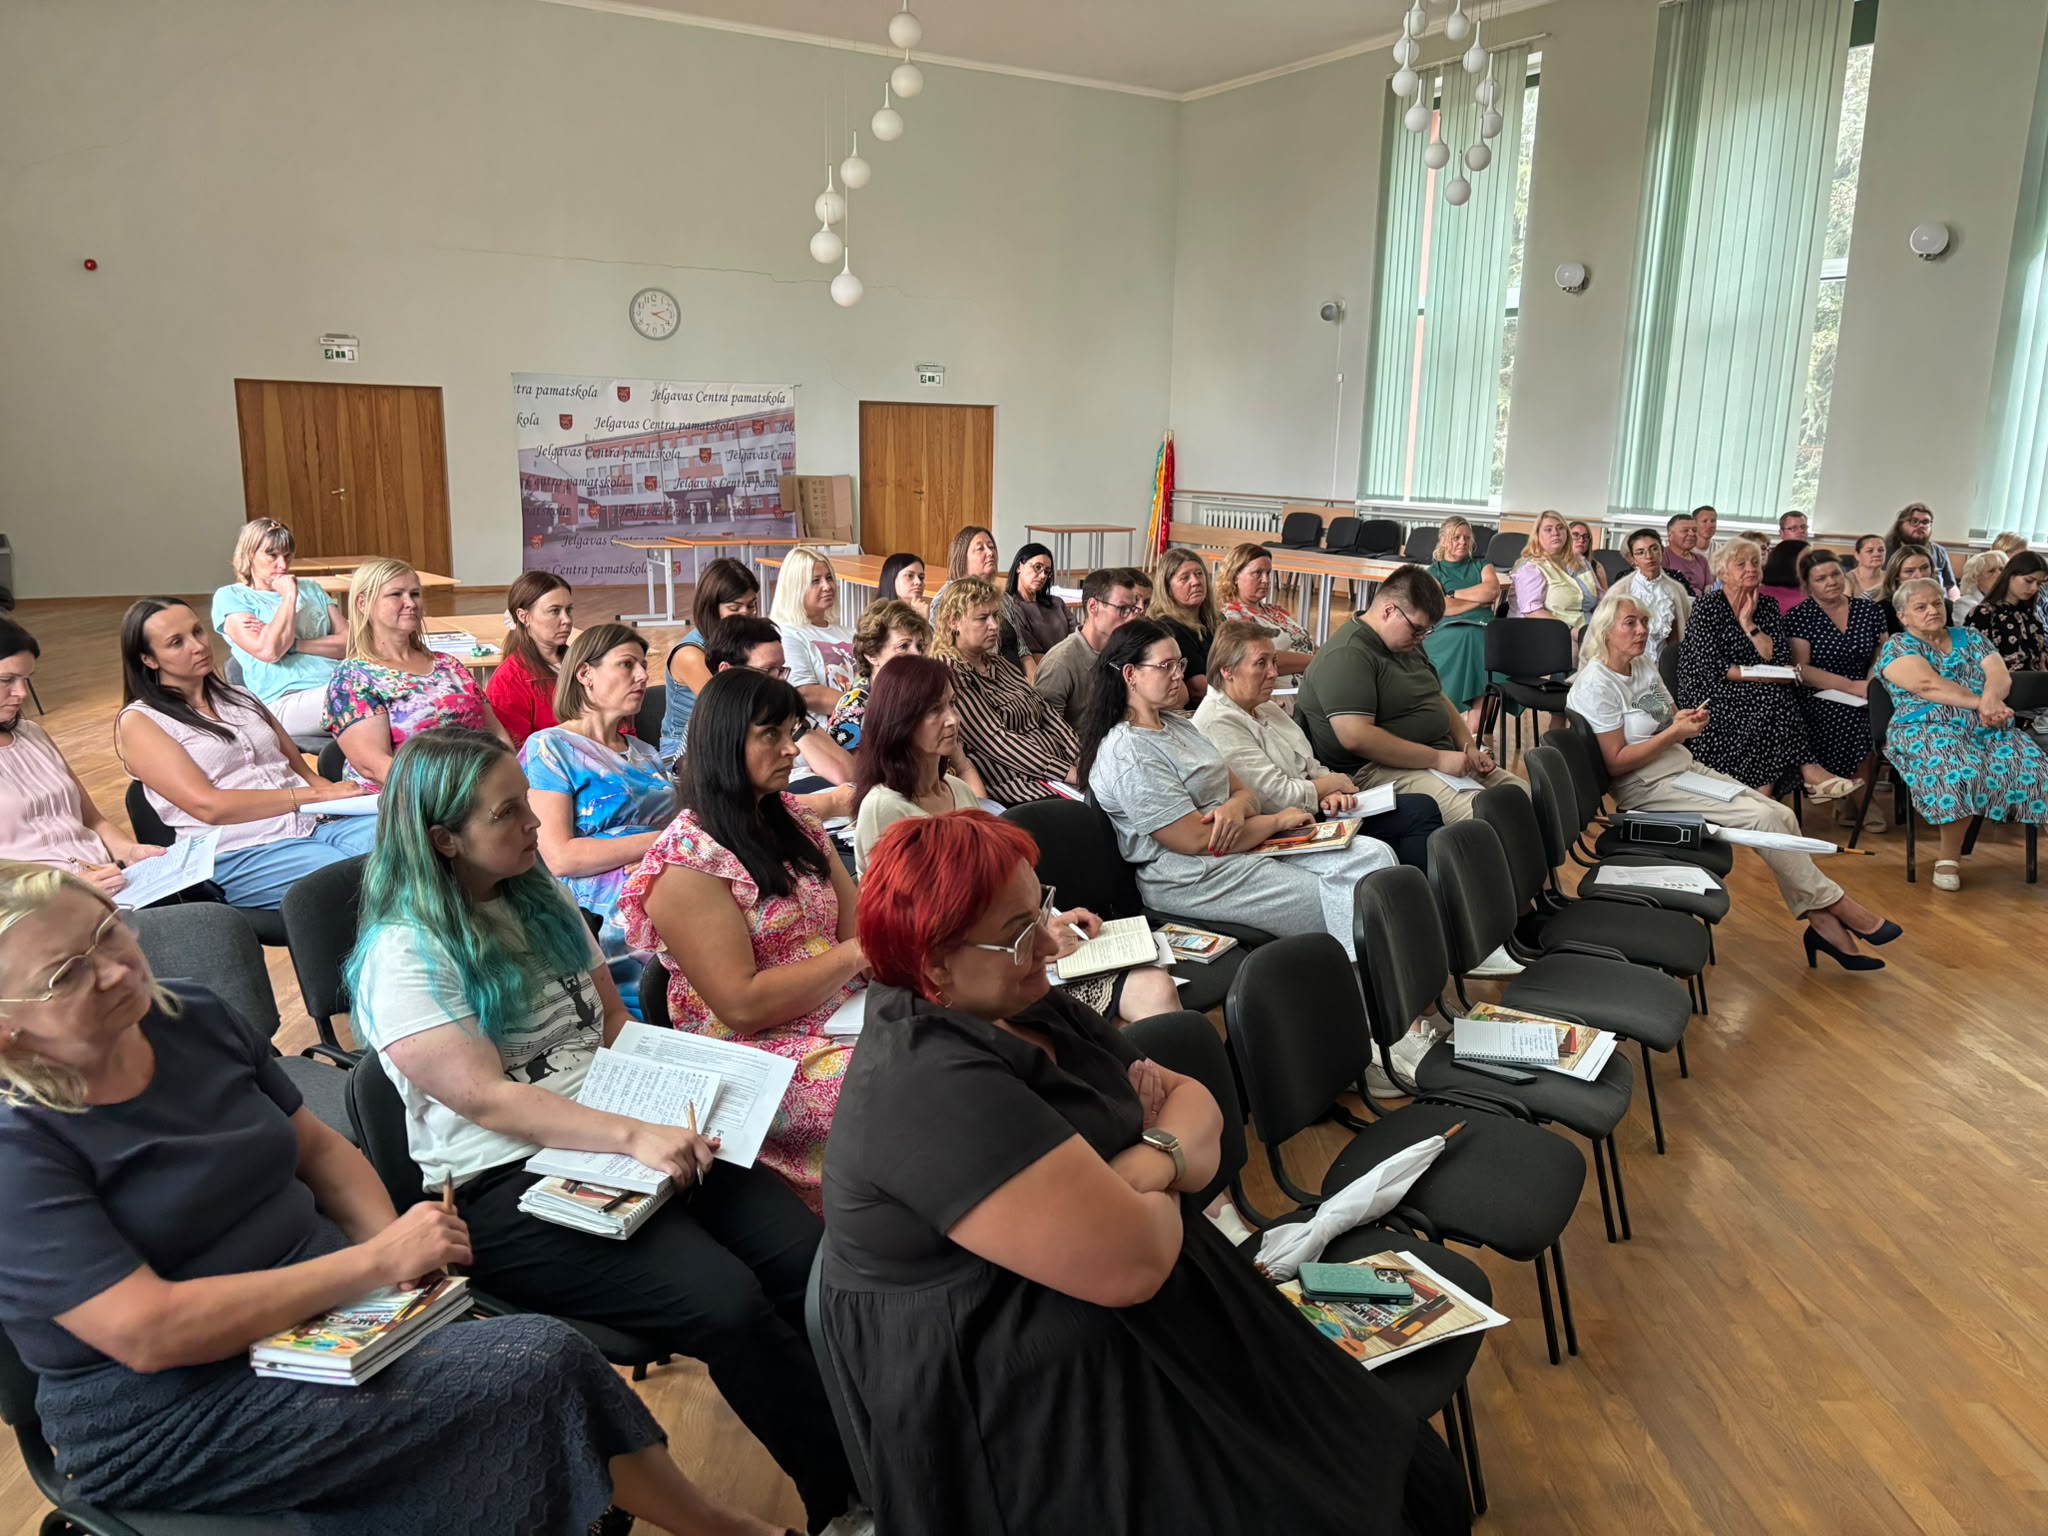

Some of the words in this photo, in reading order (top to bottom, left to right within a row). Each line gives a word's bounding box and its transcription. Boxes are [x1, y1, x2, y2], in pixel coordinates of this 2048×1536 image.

[535, 384, 598, 400] pamatskola
[651, 388, 693, 404] Jelgavas
[695, 391, 728, 403] Centra
[731, 391, 786, 406] pamatskola
[516, 412, 539, 428] kola
[594, 415, 640, 432] Jelgavas
[642, 418, 675, 432] Centra
[678, 419, 735, 433] pamatskola
[535, 444, 582, 460] Jelgavas
[585, 446, 619, 459] Centra
[622, 447, 681, 462] pamatskola
[726, 449, 768, 463] Jelgavas
[771, 450, 794, 461] Cent
[525, 475, 563, 487] Centra
[566, 475, 627, 490] pamatskola
[673, 476, 717, 491] Jelgavas
[720, 478, 751, 489] Centra
[561, 533, 607, 549] Jelgavas
[552, 561, 588, 575] Centra
